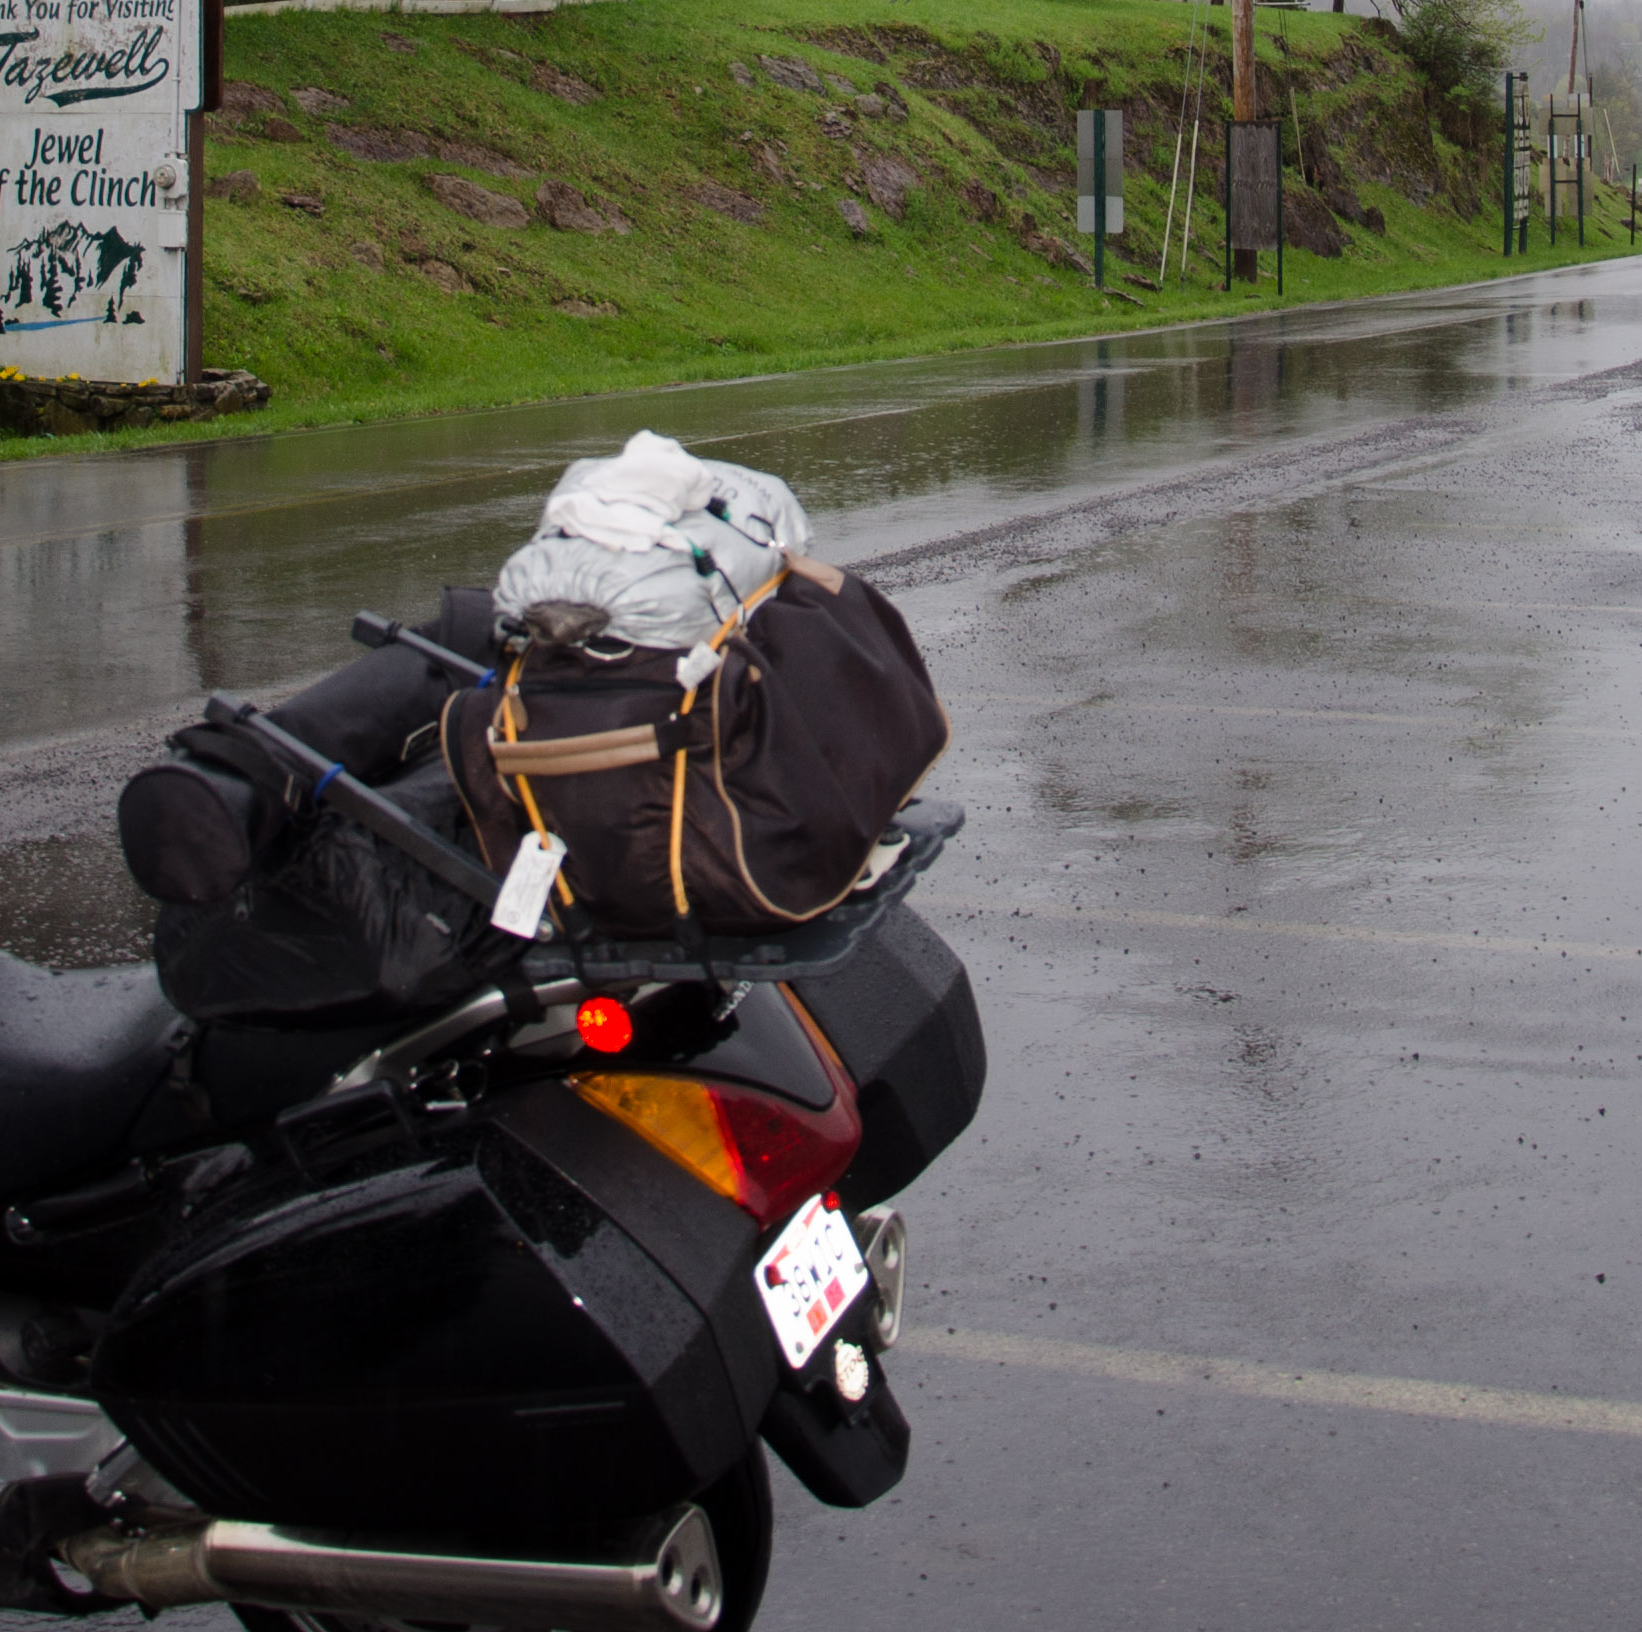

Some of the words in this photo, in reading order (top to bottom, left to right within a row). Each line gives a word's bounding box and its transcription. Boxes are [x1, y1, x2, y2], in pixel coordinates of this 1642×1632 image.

[24, 127, 104, 170] Jewel
[15, 169, 61, 206] the
[70, 168, 156, 207] Clinch
